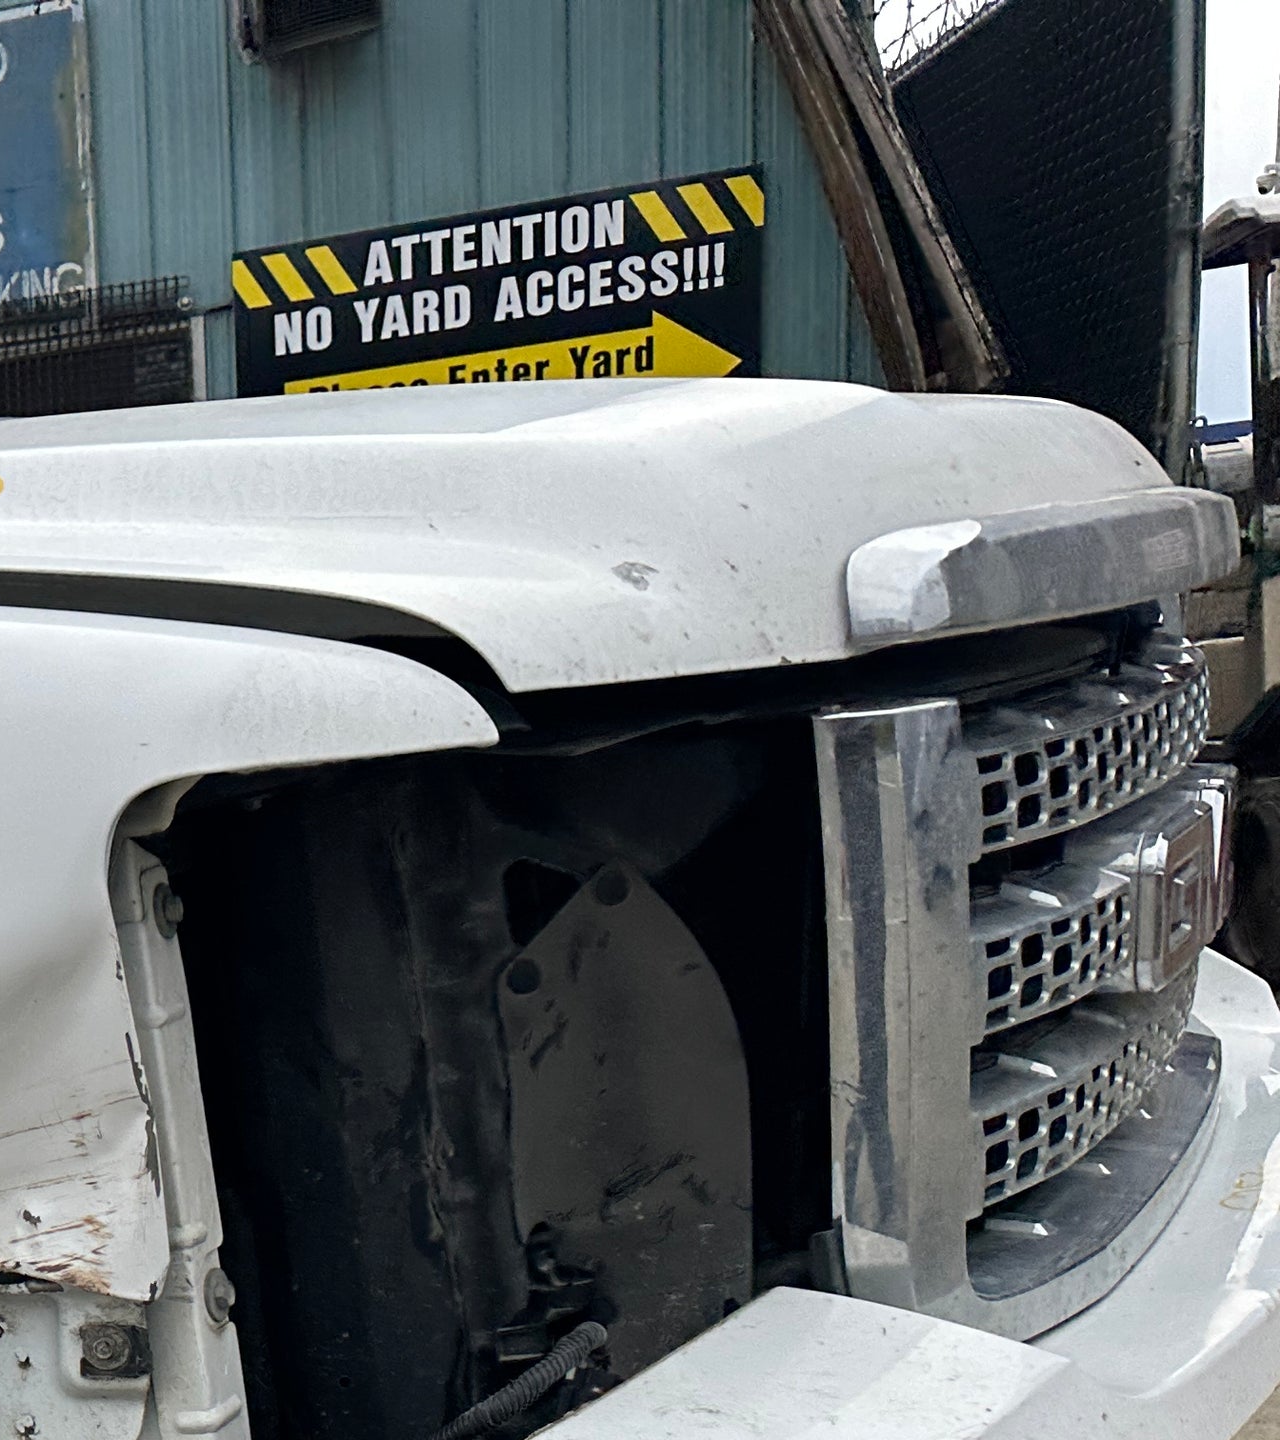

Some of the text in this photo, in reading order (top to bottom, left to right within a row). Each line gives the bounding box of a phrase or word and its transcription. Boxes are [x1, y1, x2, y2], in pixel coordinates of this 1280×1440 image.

[364, 200, 625, 287] ATTENTION
[274, 242, 726, 356] NO YARD ACCESS!!!
[569, 336, 654, 379] Yard
